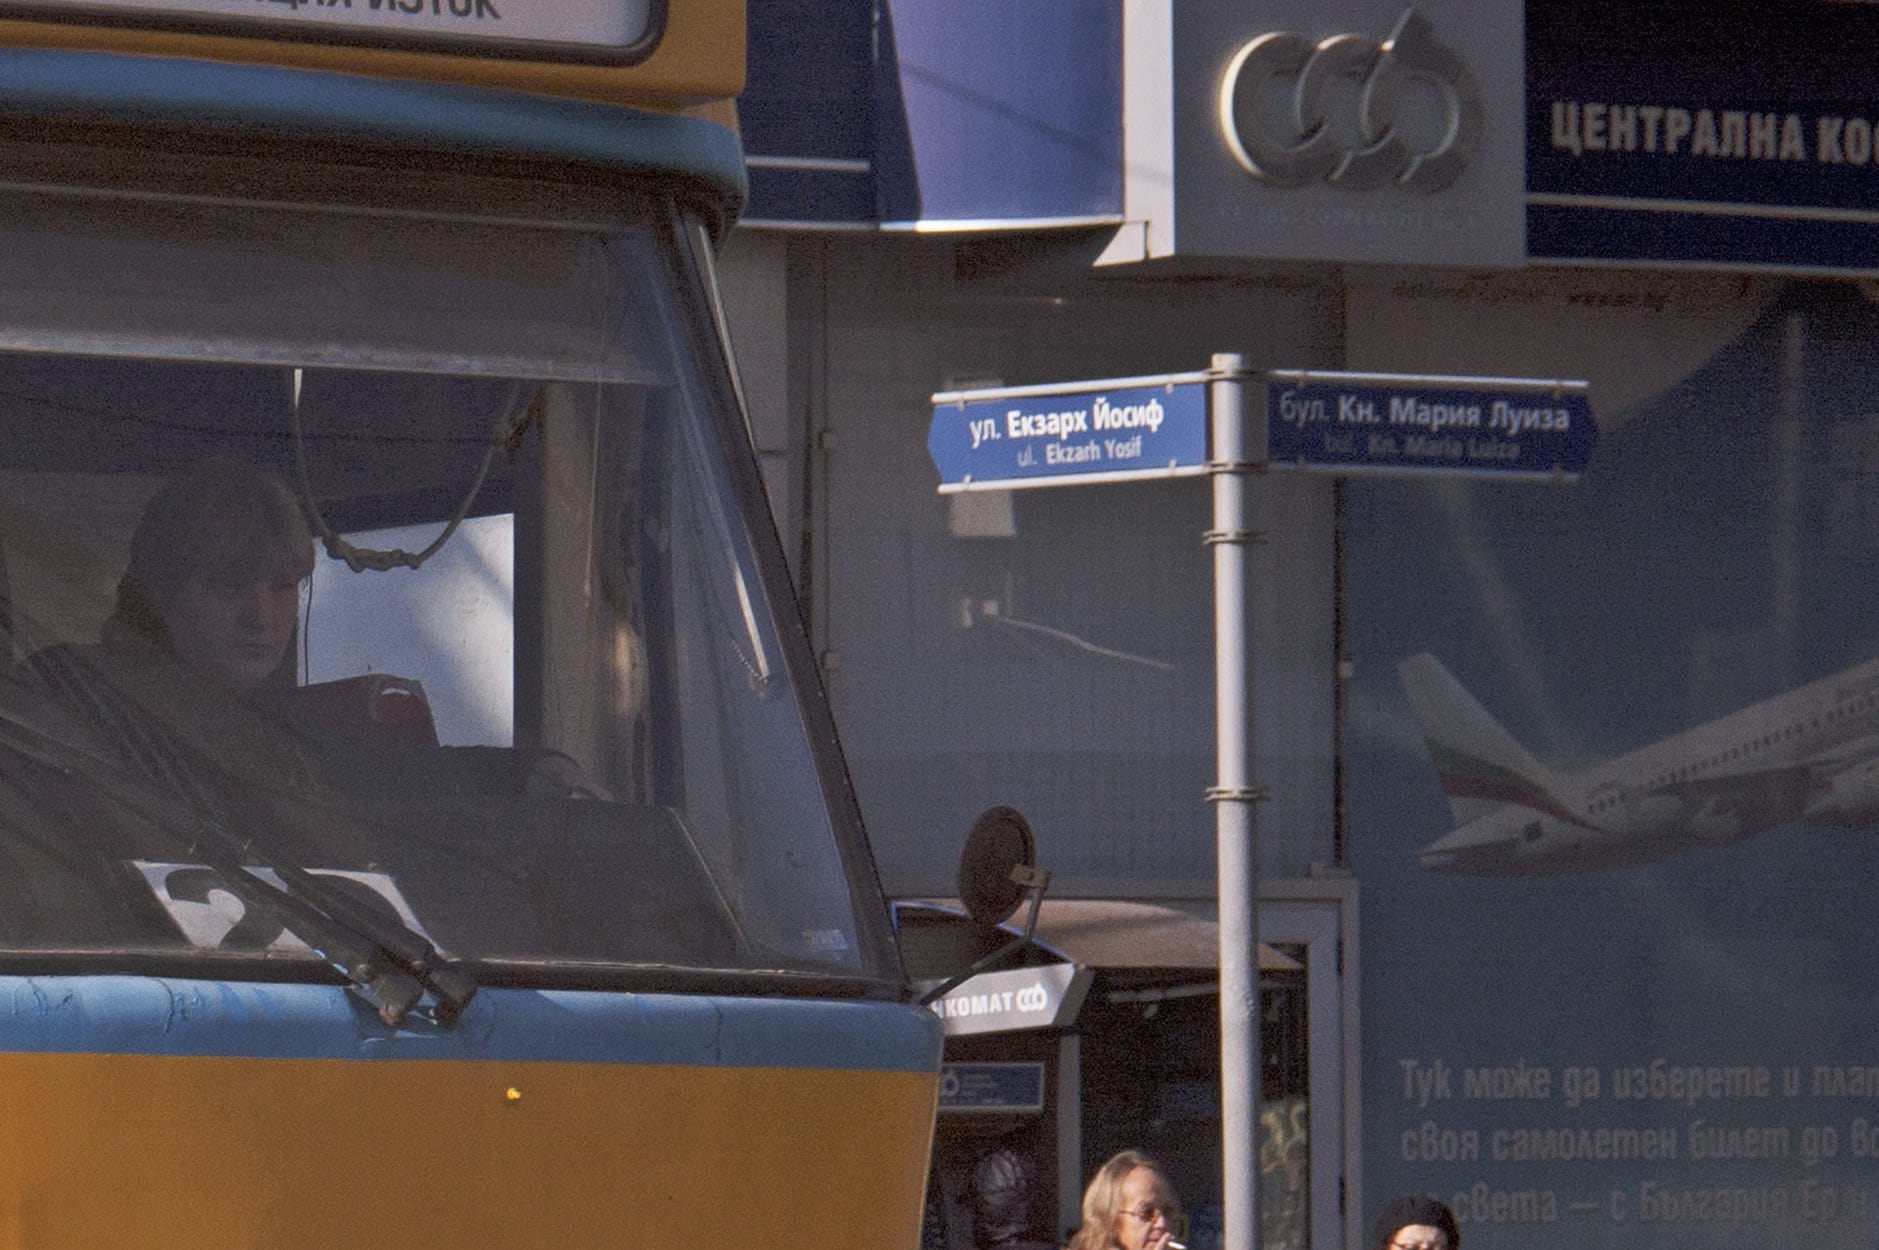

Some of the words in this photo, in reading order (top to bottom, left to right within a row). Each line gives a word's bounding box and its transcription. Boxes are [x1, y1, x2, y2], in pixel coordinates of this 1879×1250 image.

[1551, 99, 1806, 160] ЦЕНТРАЛНА
[1817, 116, 1879, 165] КО
[970, 418, 1001, 448] ул.
[1007, 410, 1087, 440] Екзарх
[1093, 397, 1164, 433] Йосиф
[1279, 390, 1328, 427] бул.
[1338, 396, 1380, 423] Кн.
[1389, 398, 1481, 431] Мария
[1488, 401, 1570, 436] Луиза
[1017, 446, 1037, 467] ul.
[1046, 440, 1100, 465] Ekzarh
[1105, 435, 1142, 459] Yosif
[1399, 1058, 1451, 1108] Тук
[1464, 1058, 1550, 1098] може
[1562, 1067, 1600, 1108] да
[1612, 1058, 1770, 1107] изберете
[1783, 1067, 1800, 1097] и
[1400, 1120, 1479, 1161] своя
[1492, 1128, 1677, 1160] самолетен
[1689, 1119, 1789, 1160] билет
[1800, 1127, 1837, 1166] до
[1452, 1182, 1557, 1222] света
